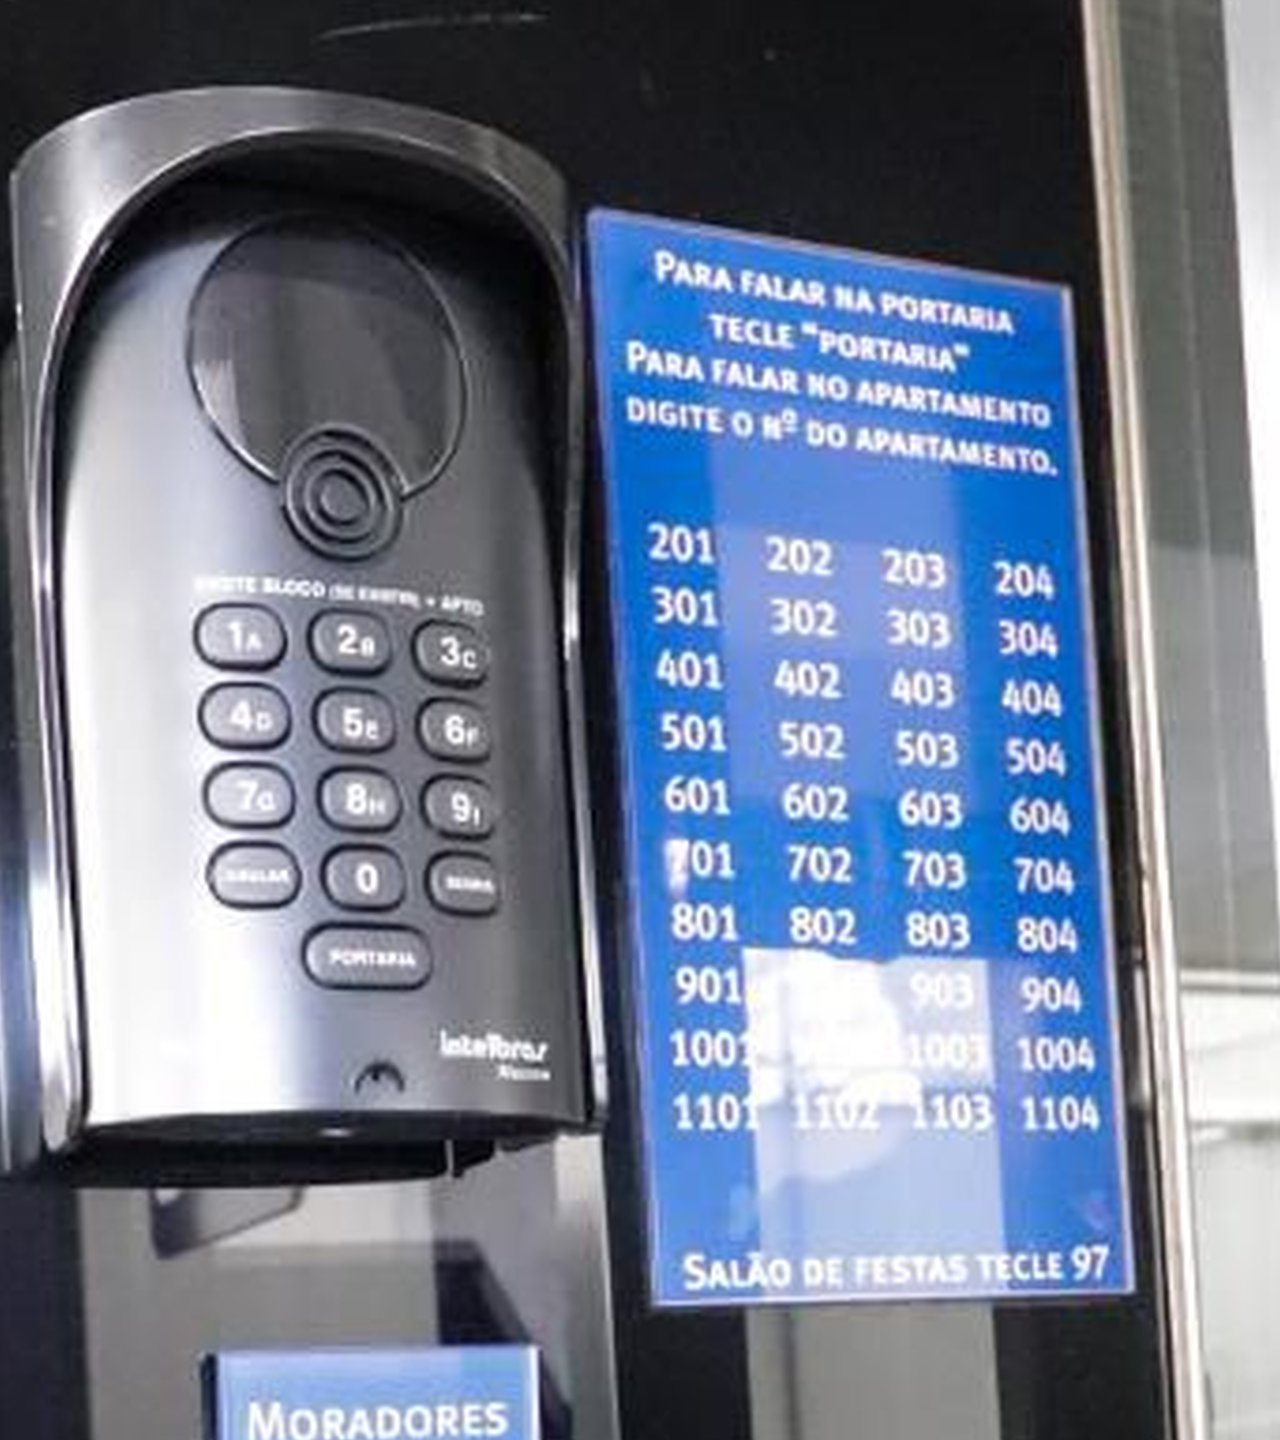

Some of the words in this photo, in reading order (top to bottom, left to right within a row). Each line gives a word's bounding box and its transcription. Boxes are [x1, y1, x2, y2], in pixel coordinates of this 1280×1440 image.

[655, 251, 732, 292] PARA
[741, 269, 826, 307] FALAR
[834, 286, 873, 314] NA
[881, 292, 1013, 334] PORTARIA
[710, 314, 793, 350] TECLE
[627, 341, 704, 380] PARA
[712, 358, 798, 393] FALAR
[807, 374, 847, 401] NO
[857, 380, 1050, 428] APARTAMENTO
[627, 398, 721, 434] DIGITE
[733, 411, 753, 437] O
[807, 421, 846, 448] DO
[856, 427, 1058, 475] APARTAMENTO.
[648, 523, 713, 563] 201
[766, 537, 832, 575] 202
[882, 549, 946, 588] 203
[995, 562, 1054, 599] 204
[652, 587, 717, 625] 301
[771, 599, 836, 636] 302
[887, 610, 951, 648] 303
[999, 622, 1058, 658] 304
[656, 652, 723, 689] 401
[774, 662, 842, 699] 402
[891, 673, 955, 708] 403
[1002, 682, 1061, 717] 404
[662, 714, 726, 751] 501
[779, 723, 845, 759] 502
[896, 734, 958, 768] 503
[1006, 740, 1066, 776] 504
[665, 777, 730, 815] 601
[782, 785, 849, 821] 602
[899, 792, 963, 829] 603
[1010, 800, 1070, 835] 604
[356, 864, 378, 895] 0
[787, 846, 852, 883] 702
[903, 852, 967, 889] 703
[1014, 859, 1074, 894] 704
[671, 903, 738, 942] 801
[790, 908, 856, 945] 802
[906, 913, 970, 948] 803
[1018, 918, 1077, 953] 804
[676, 967, 741, 1003] 901
[910, 972, 972, 1010] 903
[1021, 978, 1080, 1014] 904
[1018, 1038, 1094, 1071] 1004
[674, 1095, 760, 1130] 1101
[912, 1095, 994, 1130] 1103
[1022, 1098, 1099, 1130] 1104
[683, 1252, 792, 1291] SALÃO
[804, 1259, 843, 1286] DE
[856, 1255, 967, 1285] FESTAS
[977, 1251, 1063, 1281] TECLE
[1072, 1245, 1110, 1280] 97
